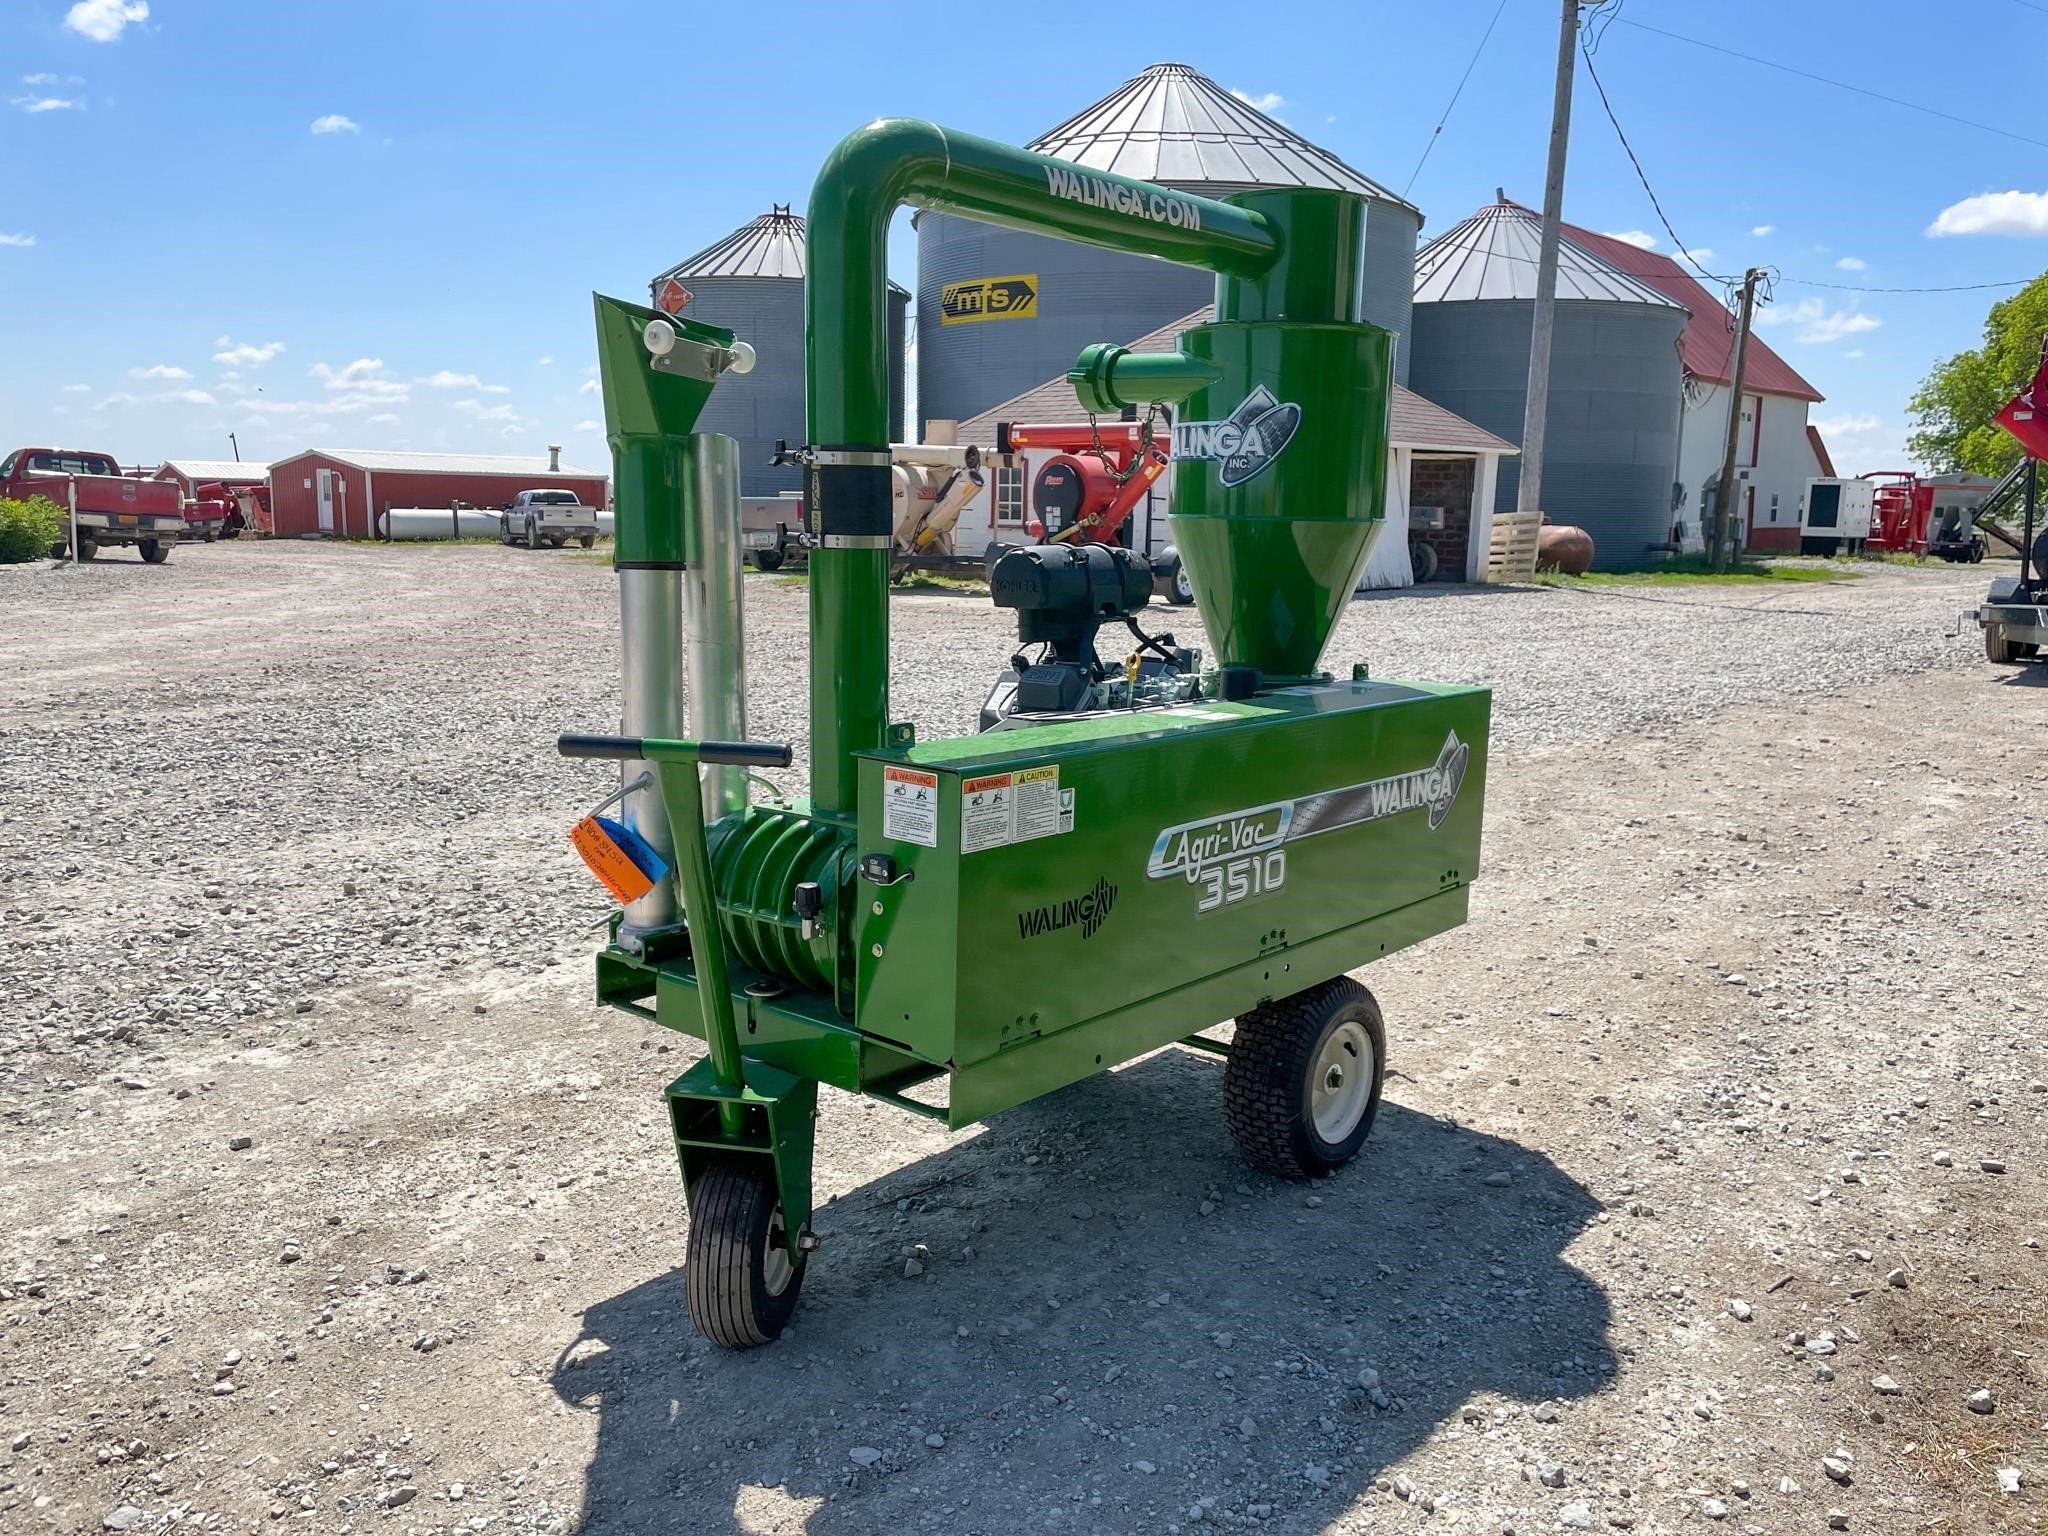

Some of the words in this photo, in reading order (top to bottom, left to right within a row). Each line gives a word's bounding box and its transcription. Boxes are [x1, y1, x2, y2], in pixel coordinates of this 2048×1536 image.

[956, 280, 1010, 314] mfs
[1171, 424, 1266, 457] ALINGA
[899, 770, 932, 786] WARNING
[976, 775, 1007, 789] WARNING
[1026, 769, 1054, 781] CAUTION
[1371, 768, 1452, 817] WALINGA
[1176, 818, 1265, 884] Agri-Vac
[1198, 849, 1287, 914] 3510
[1018, 892, 1110, 940] WALINGA
